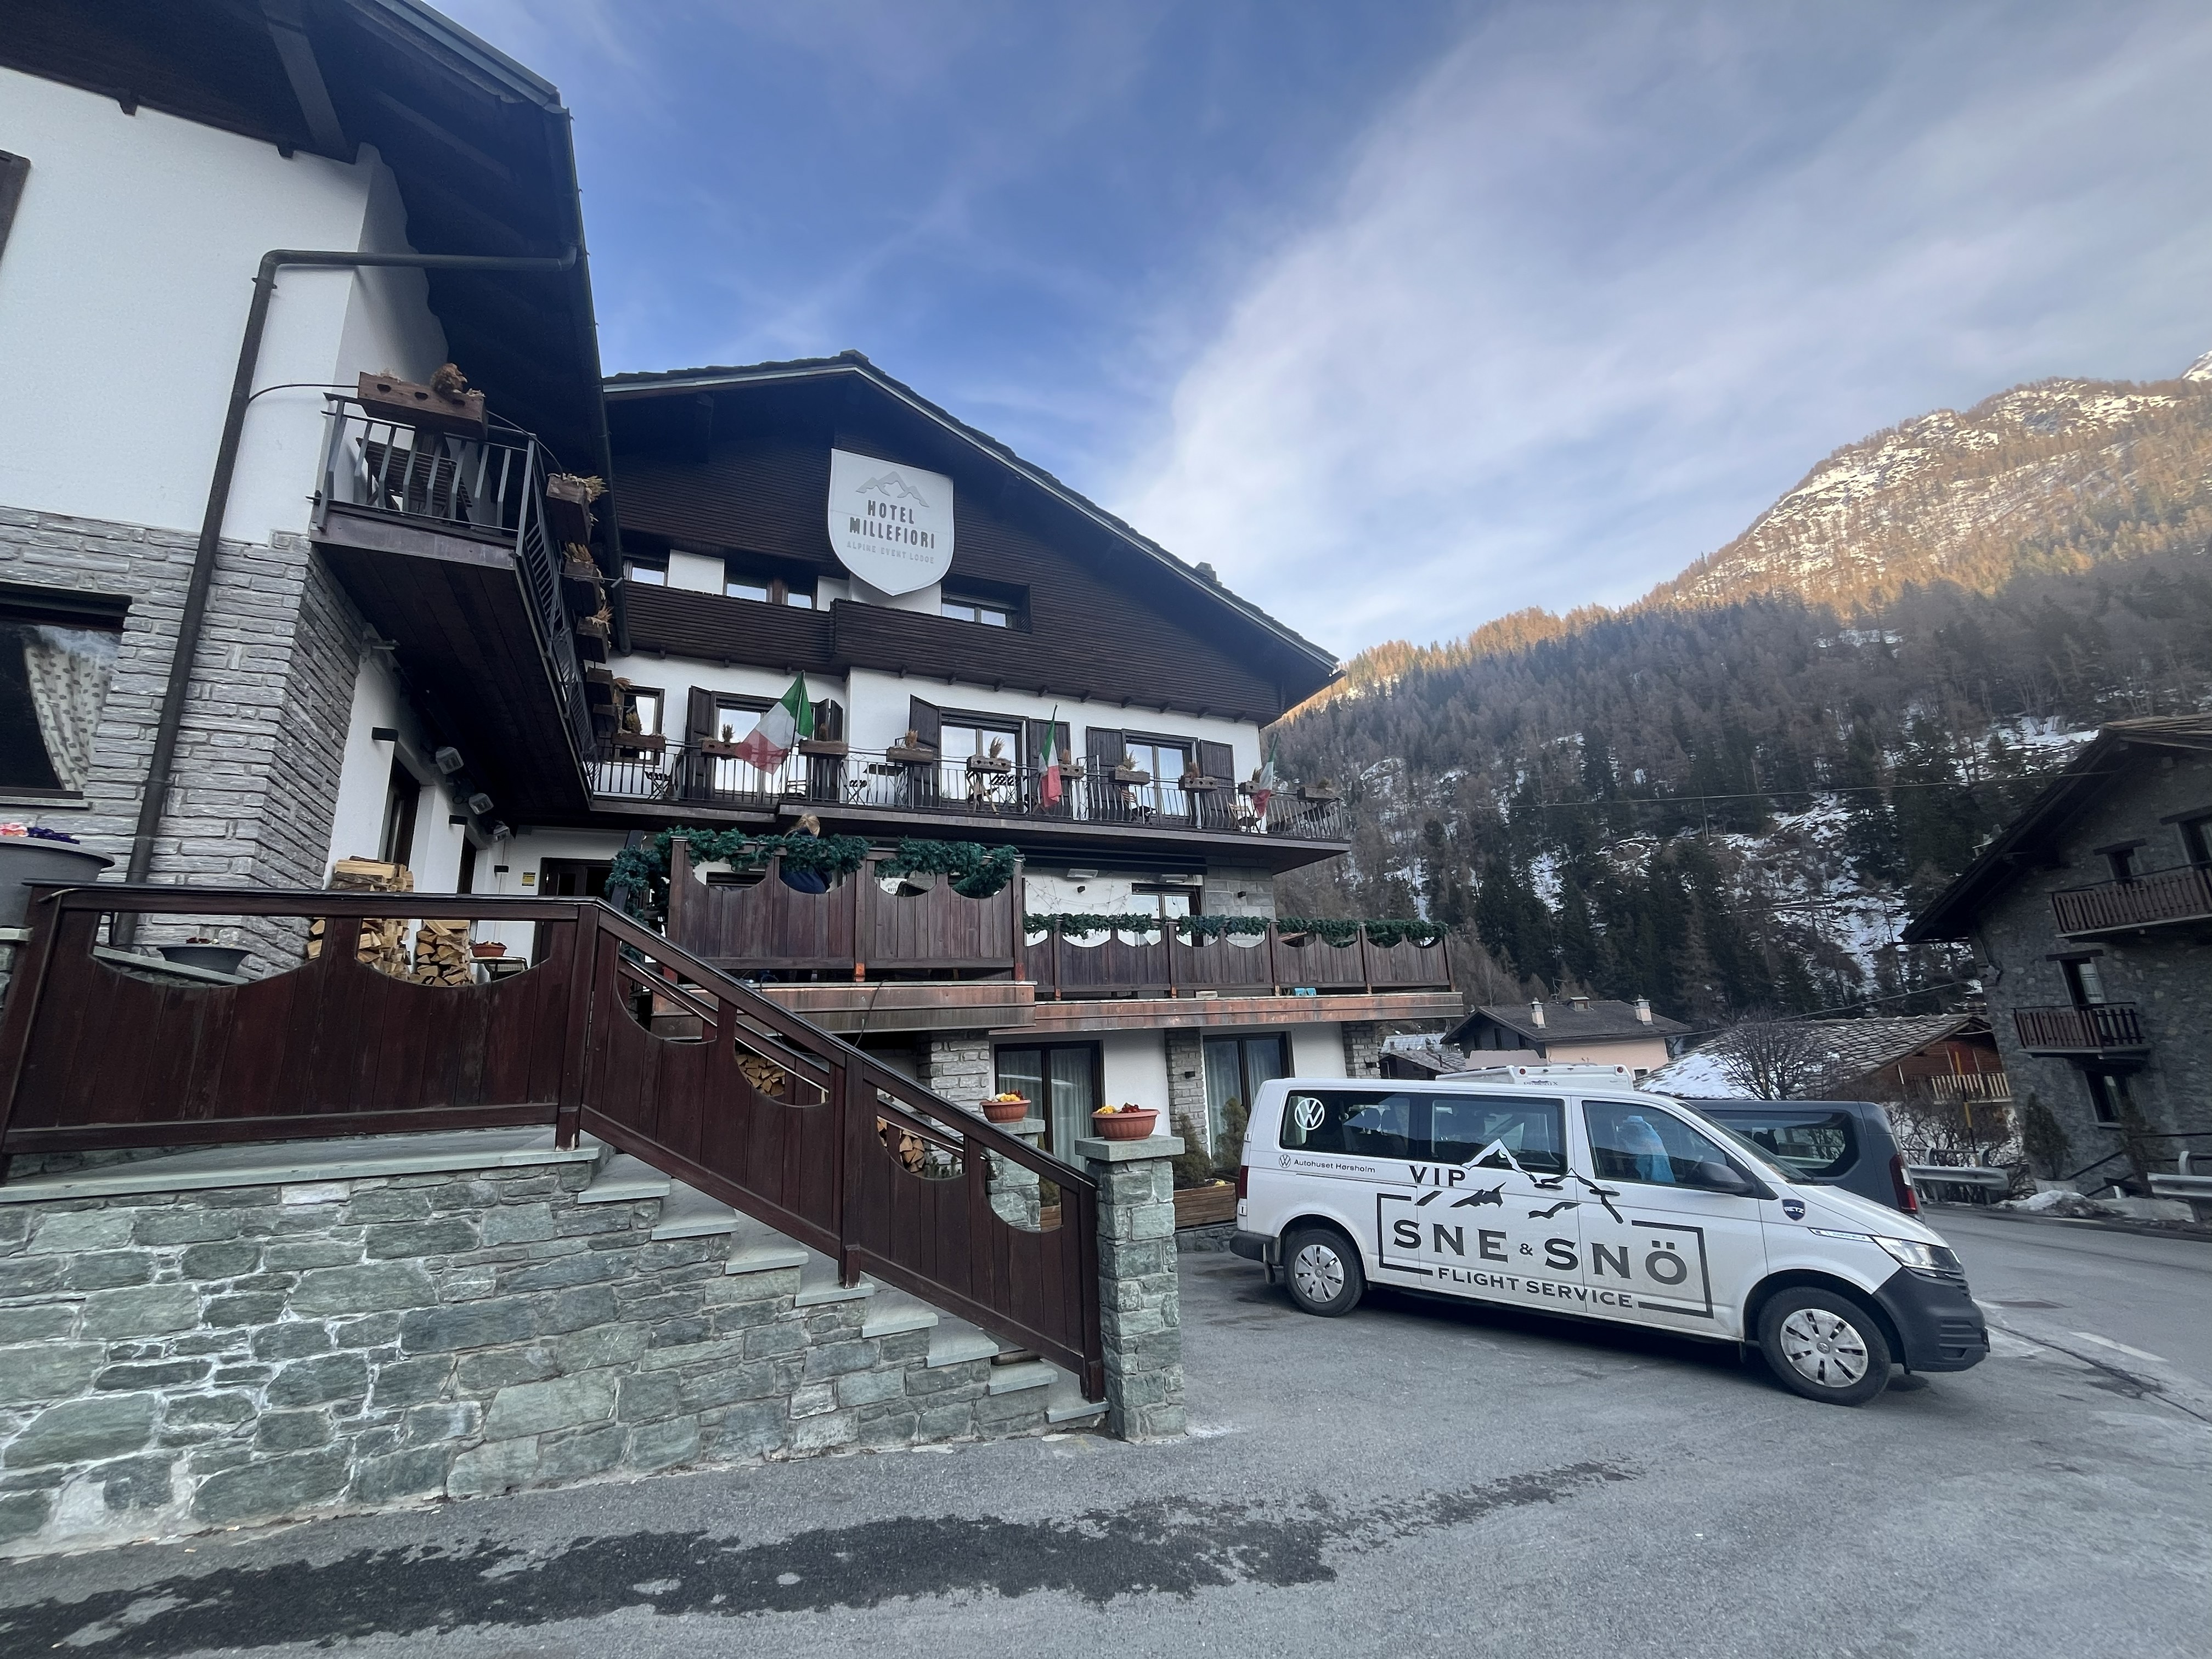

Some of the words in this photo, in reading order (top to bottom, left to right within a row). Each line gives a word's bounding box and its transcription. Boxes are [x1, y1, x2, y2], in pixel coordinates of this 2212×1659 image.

[867, 500, 915, 524] HOTEL
[849, 517, 934, 549] MILLEFIORI
[847, 541, 877, 553] ALPINE
[881, 547, 906, 558] EVENT
[910, 552, 934, 564] LODGE
[1294, 1159, 1334, 1169] Autohuset
[1335, 1163, 1375, 1173] Hørsholm
[1409, 1165, 1466, 1187] VIP
[1393, 1220, 1509, 1263] SNE
[1519, 1243, 1533, 1256] &
[1544, 1238, 1688, 1285] SNÖ
[1438, 1267, 1519, 1291] FLIGHT
[1526, 1280, 1633, 1308] SERVICE
